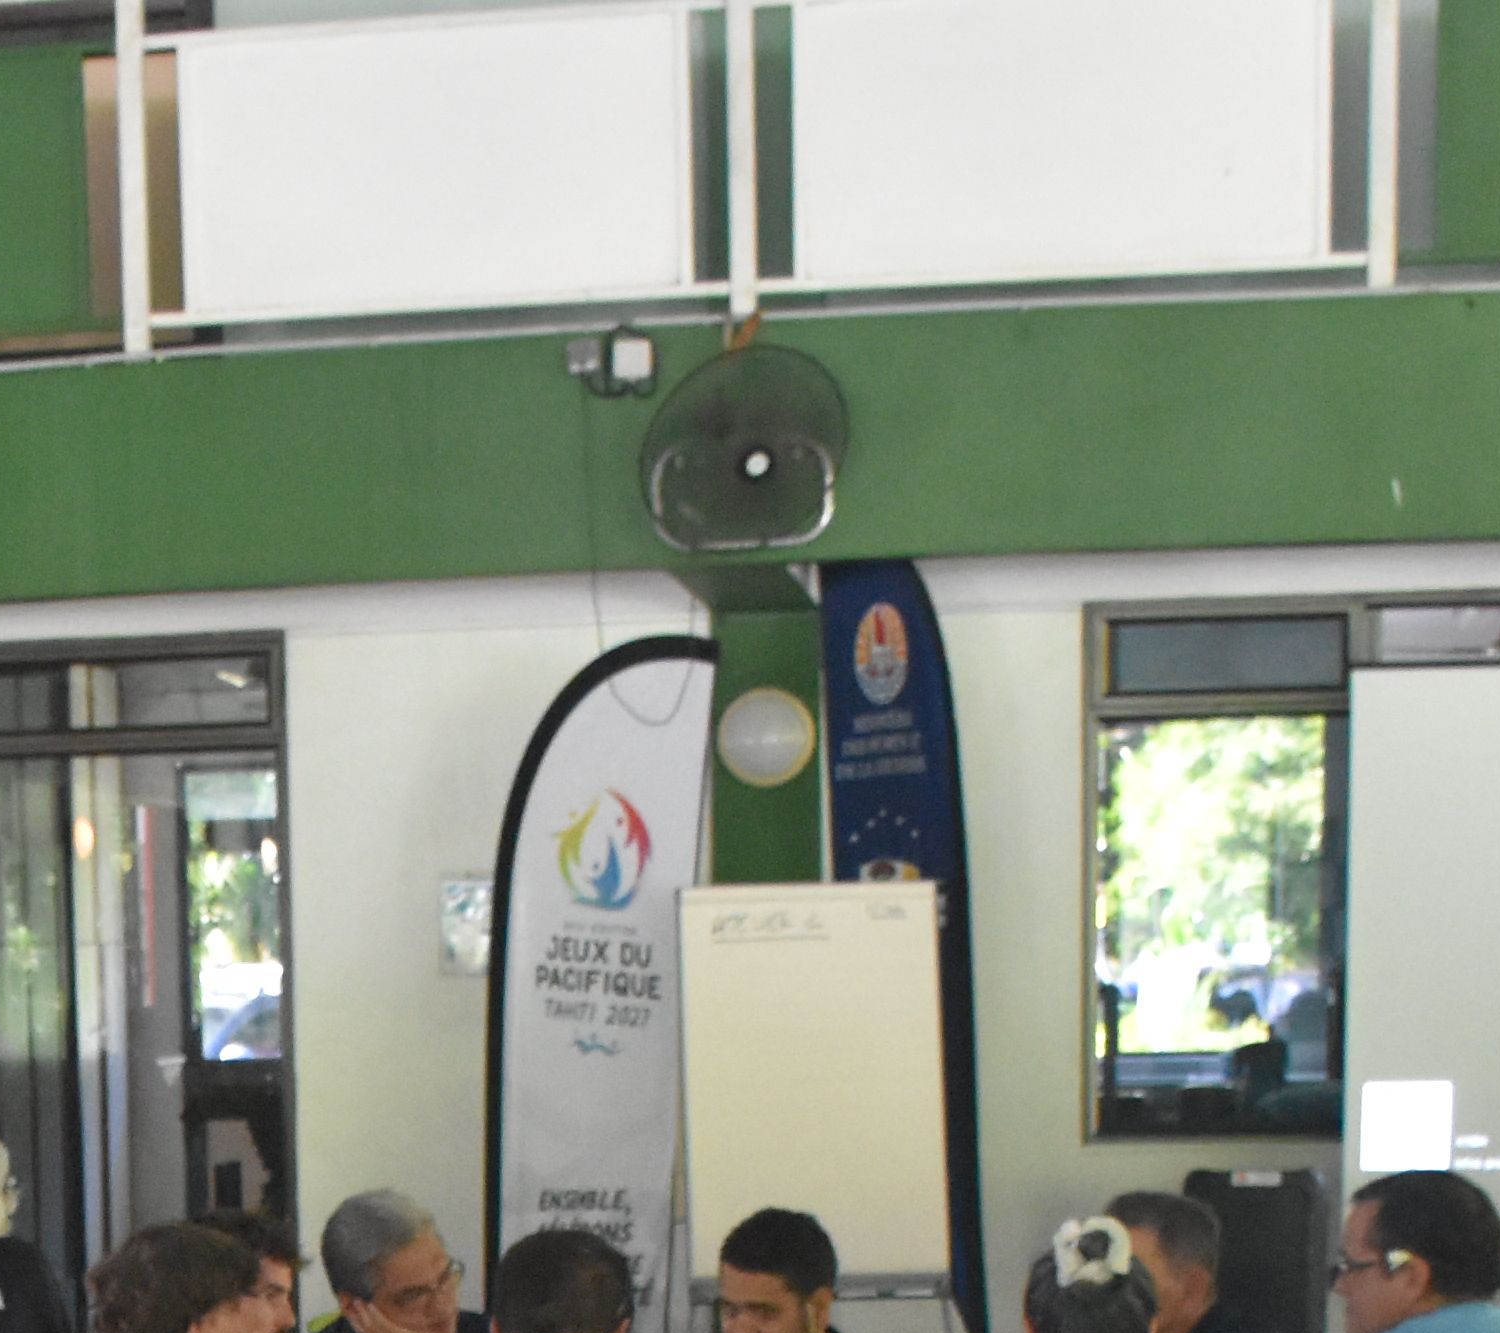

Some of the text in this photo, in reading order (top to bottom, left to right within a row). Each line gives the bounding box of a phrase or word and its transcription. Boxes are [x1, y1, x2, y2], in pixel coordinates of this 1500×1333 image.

[545, 935, 652, 969] JEUX DU
[534, 964, 663, 1001] PACIFIQUE
